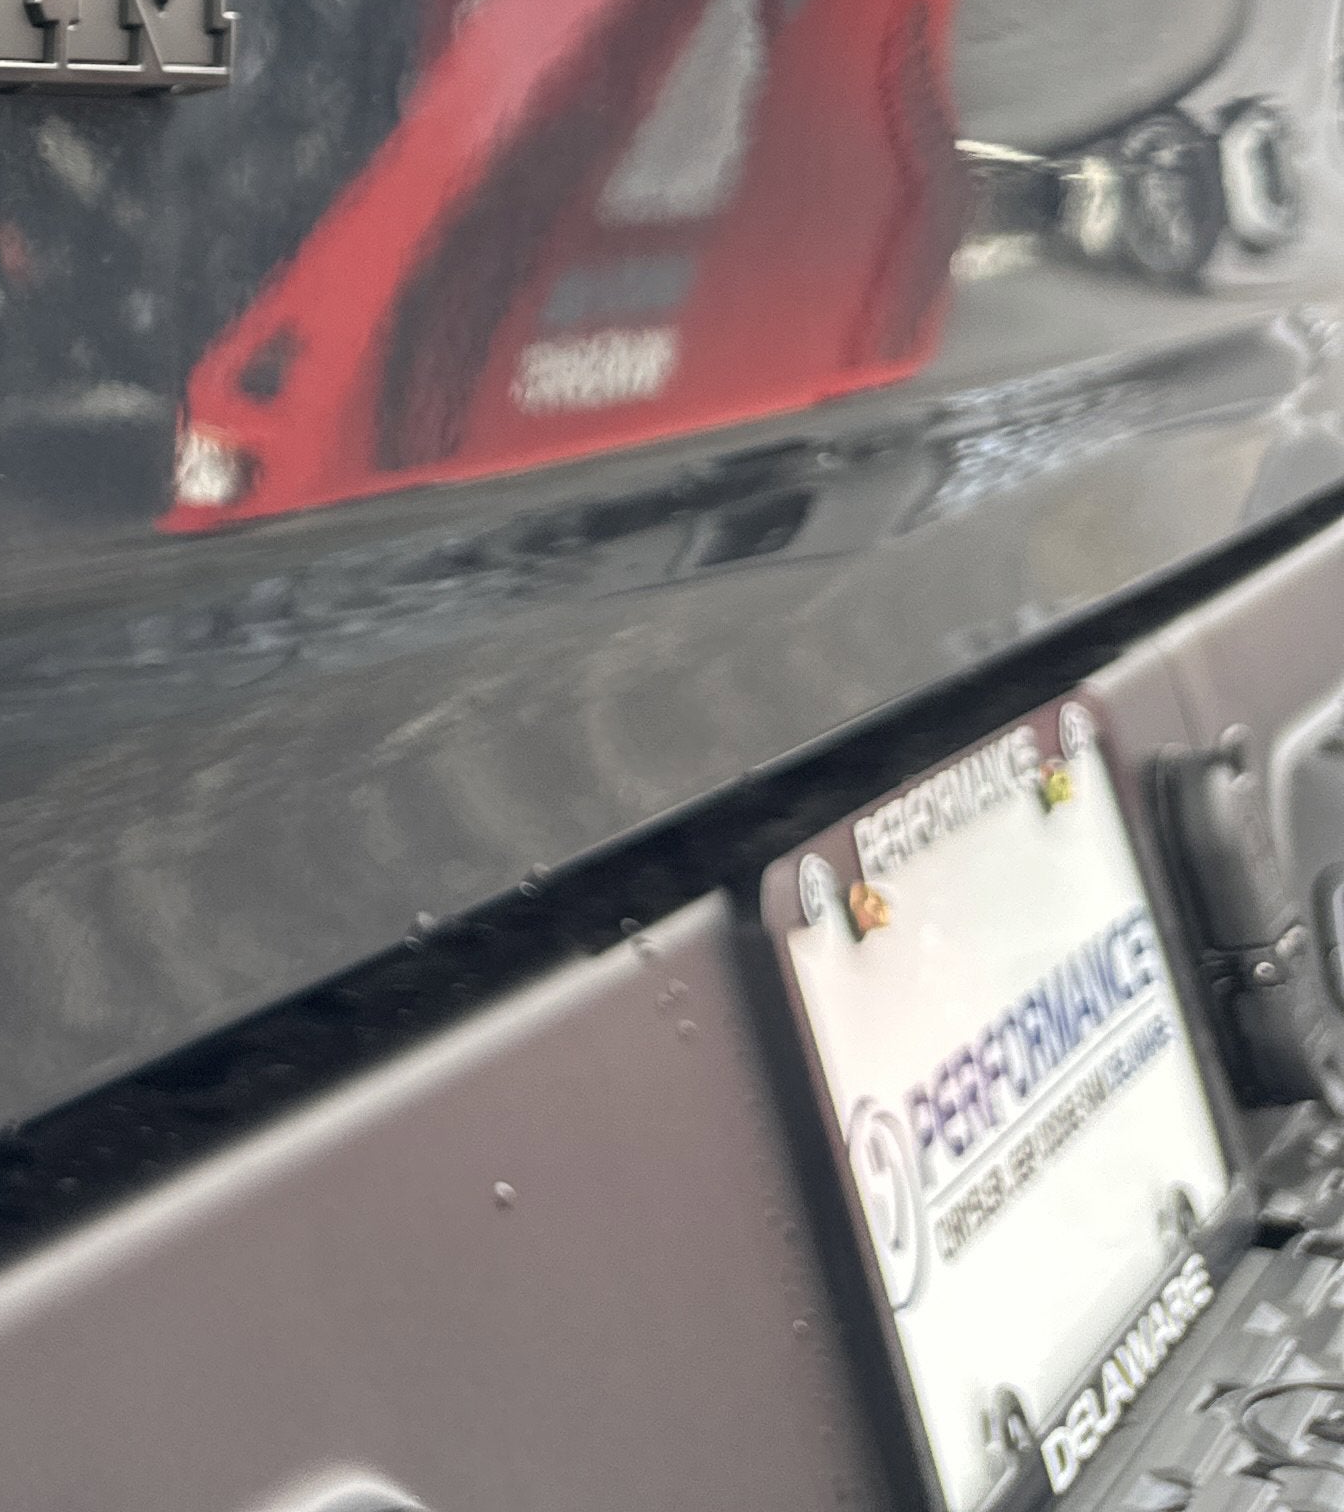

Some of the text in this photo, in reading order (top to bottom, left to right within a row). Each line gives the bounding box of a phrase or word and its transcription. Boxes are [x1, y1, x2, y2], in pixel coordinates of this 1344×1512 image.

[853, 724, 1049, 878] PERFORMANCE
[910, 904, 1158, 1188] PERFORMANCE
[1040, 1252, 1217, 1494] DELAWARE
